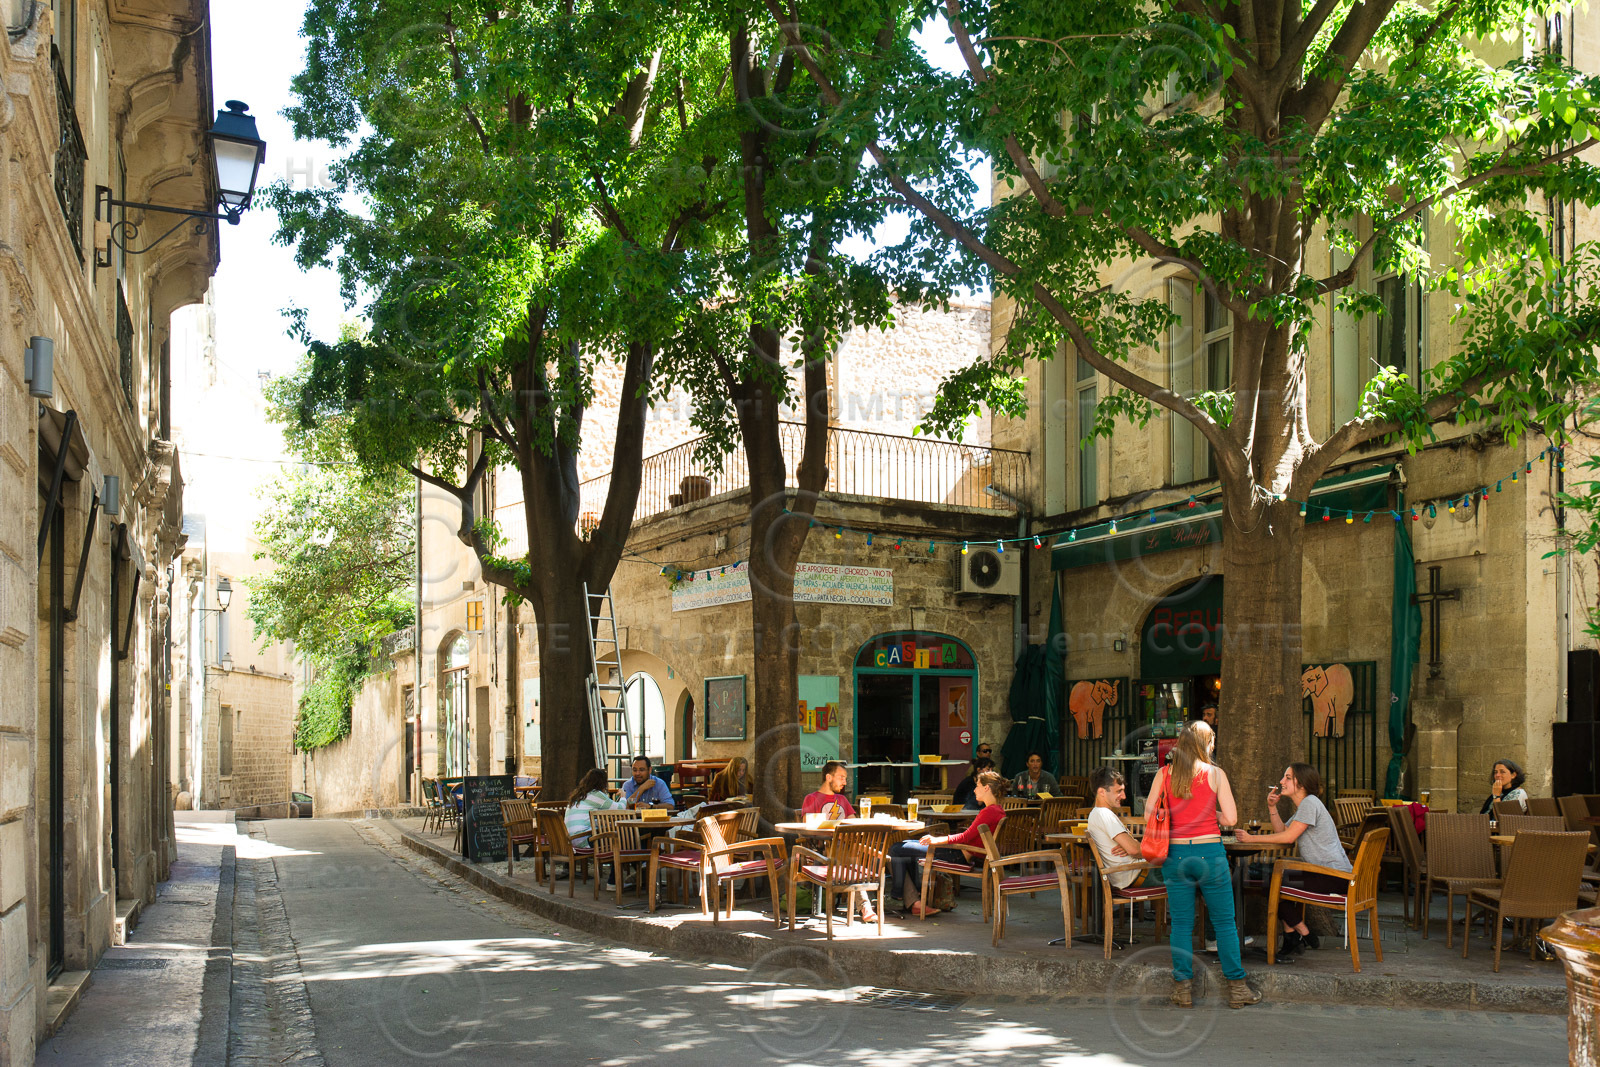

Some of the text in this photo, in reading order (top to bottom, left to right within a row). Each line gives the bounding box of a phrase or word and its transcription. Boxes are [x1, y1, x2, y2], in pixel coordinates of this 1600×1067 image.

[844, 568, 869, 576] CHORIZO
[873, 569, 885, 577] VINO
[840, 575, 864, 583] APERITIVO
[816, 593, 829, 601] PATA
[850, 595, 875, 604] COCKTAIL
